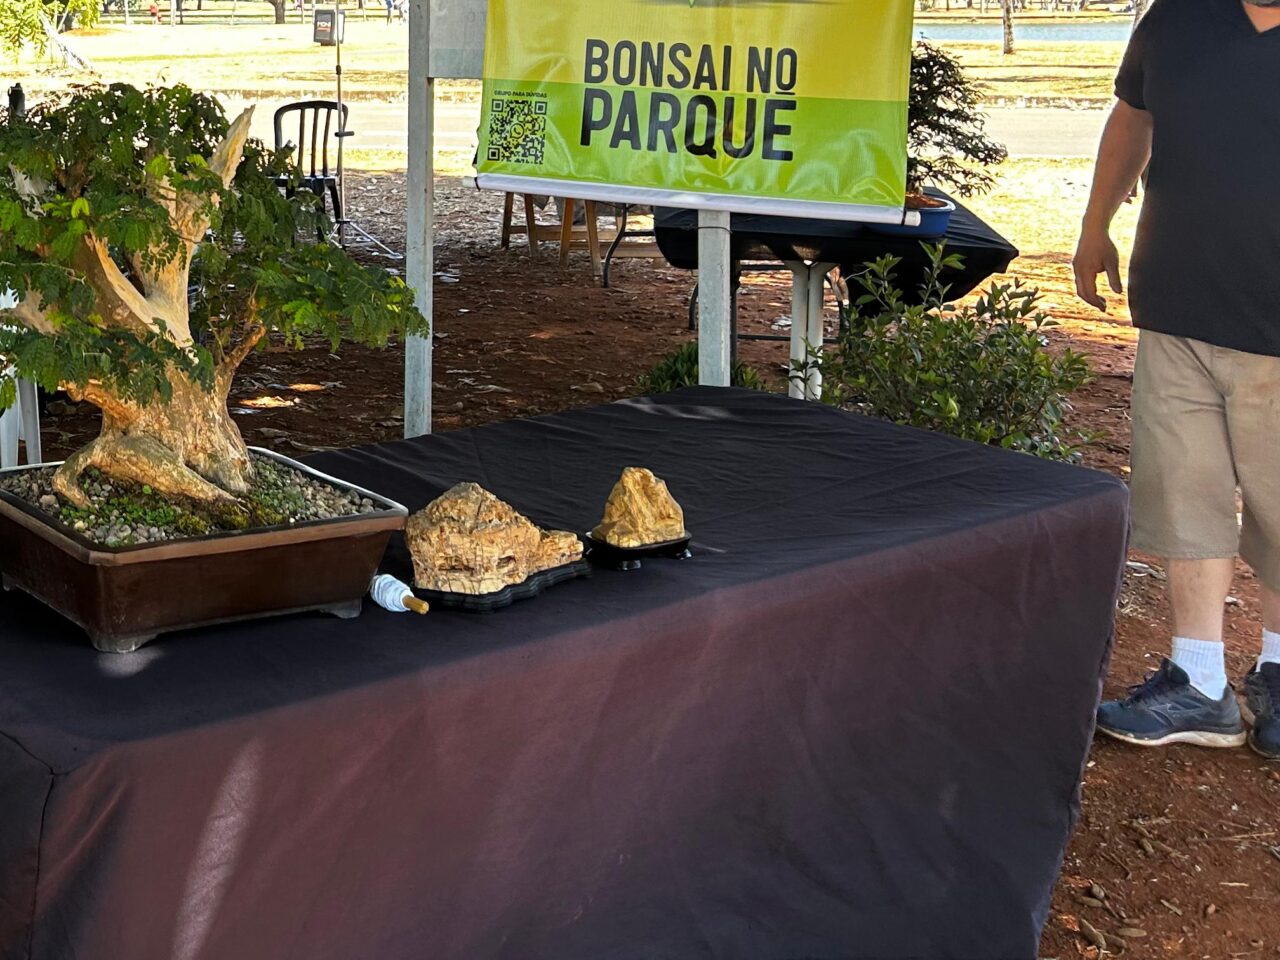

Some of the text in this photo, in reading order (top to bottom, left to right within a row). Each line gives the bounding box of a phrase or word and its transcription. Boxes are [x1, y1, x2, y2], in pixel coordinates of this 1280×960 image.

[584, 38, 798, 96] BONSAI NO
[580, 88, 797, 161] PARQUE
